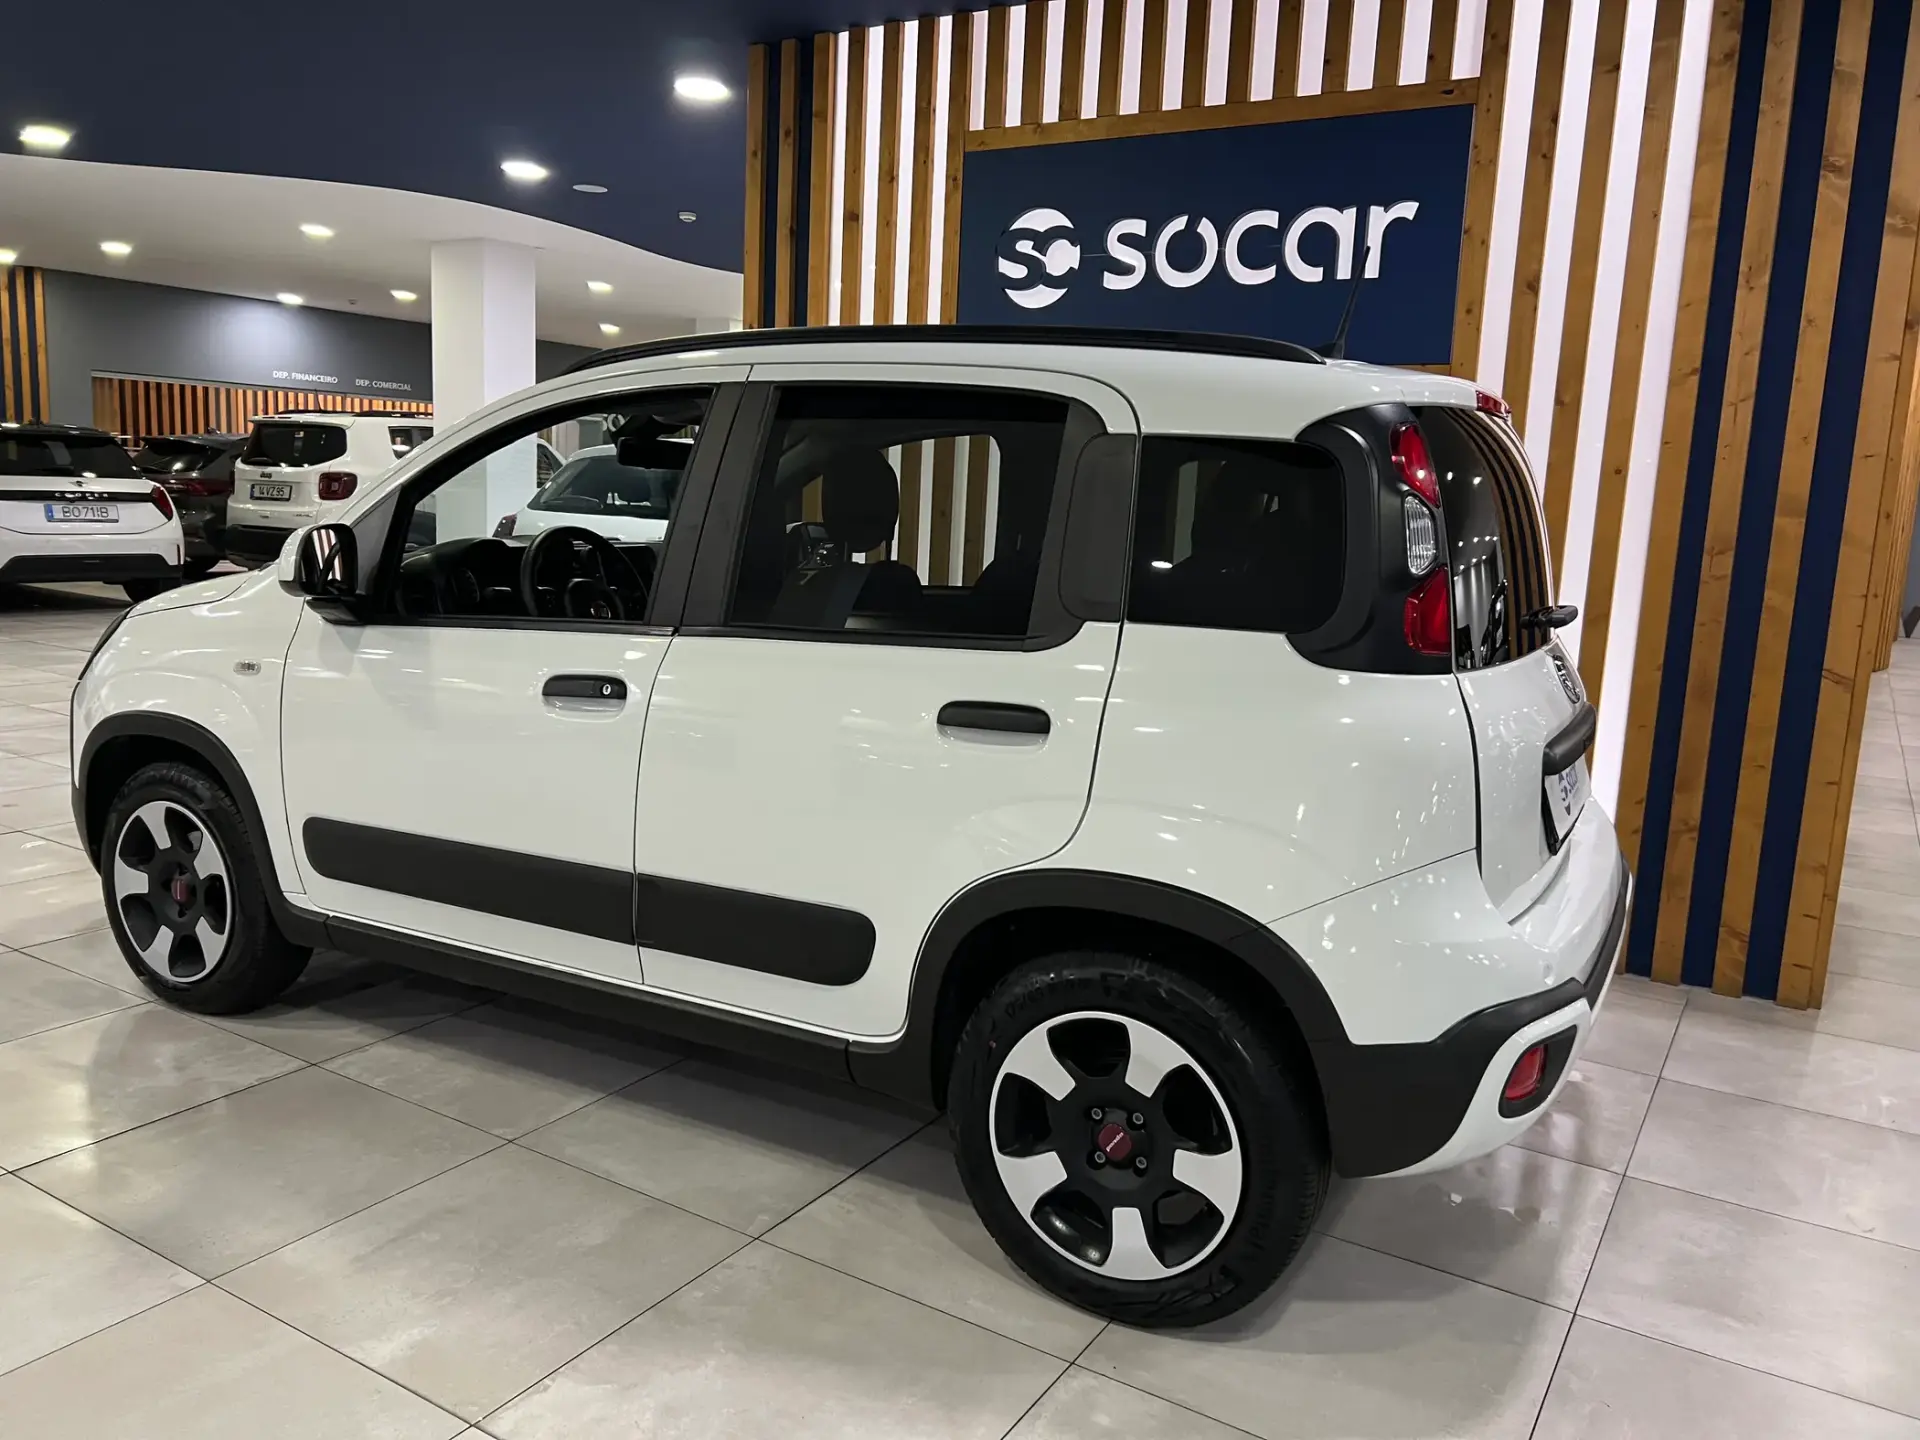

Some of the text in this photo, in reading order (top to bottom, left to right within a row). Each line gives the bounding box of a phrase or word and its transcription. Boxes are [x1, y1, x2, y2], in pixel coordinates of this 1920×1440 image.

[1102, 200, 1420, 291] socar
[272, 370, 338, 384] DEP. FINANCEIRO
[355, 378, 412, 391] DEP. COMERCIAL
